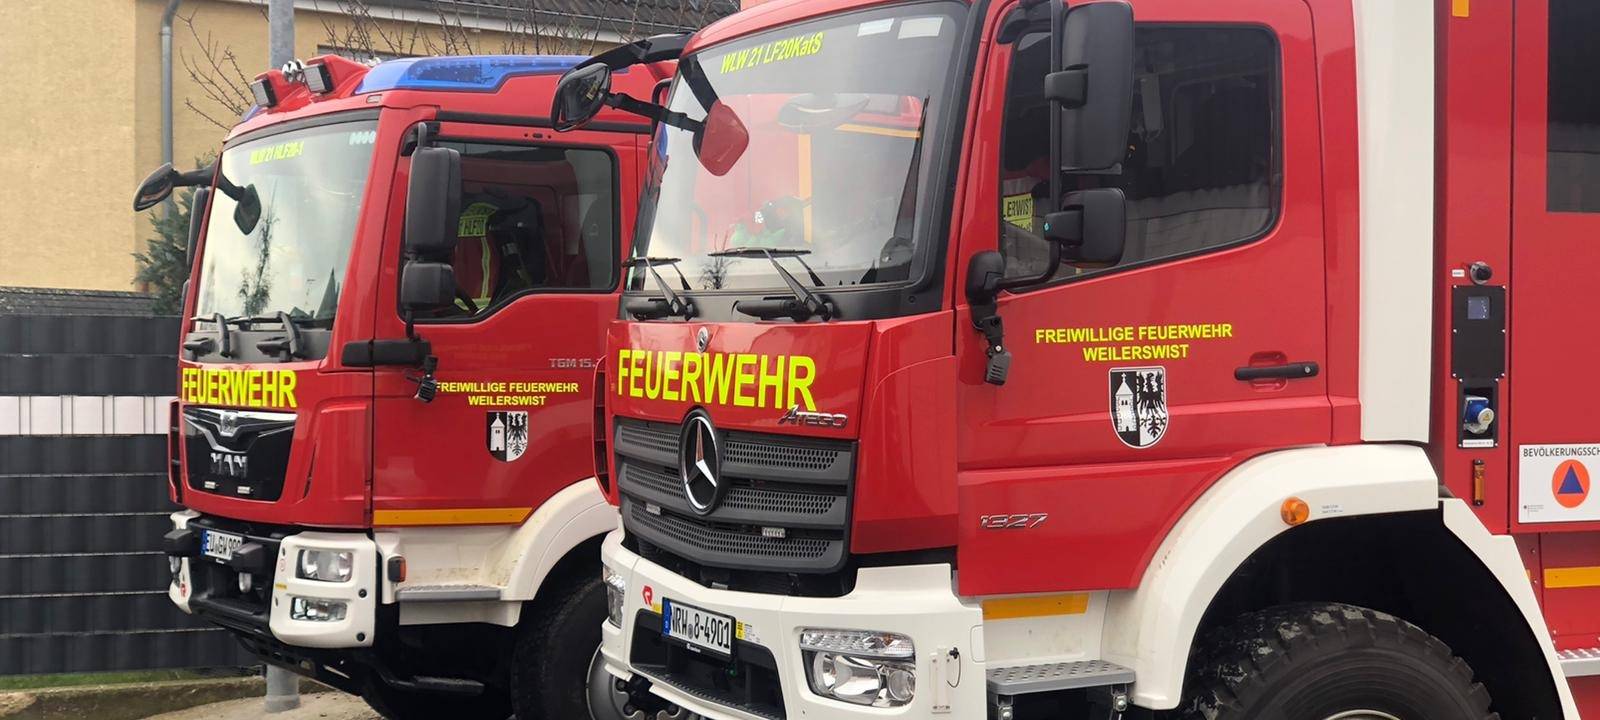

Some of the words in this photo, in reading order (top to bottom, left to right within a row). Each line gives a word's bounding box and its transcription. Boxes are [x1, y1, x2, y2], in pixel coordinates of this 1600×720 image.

[720, 50, 749, 74] WLW
[748, 45, 764, 68] 21
[763, 32, 823, 64] LF20KatS
[1035, 326, 1134, 344] FREIWILLIGE
[1138, 323, 1233, 340] FEUERWEHR
[548, 358, 576, 368] TGM
[578, 358, 599, 368] 15.
[1083, 344, 1190, 361] WEILERSWIST
[182, 368, 298, 408] FEUERWEHR
[509, 382, 579, 393] FEUERWEHR
[617, 349, 817, 412] FEUERWEHR
[468, 395, 546, 406] WEILERSWIST
[210, 452, 248, 478] MAN
[980, 512, 1048, 529] 1327
[672, 605, 688, 636] NRW
[693, 612, 730, 650] 8-4901
